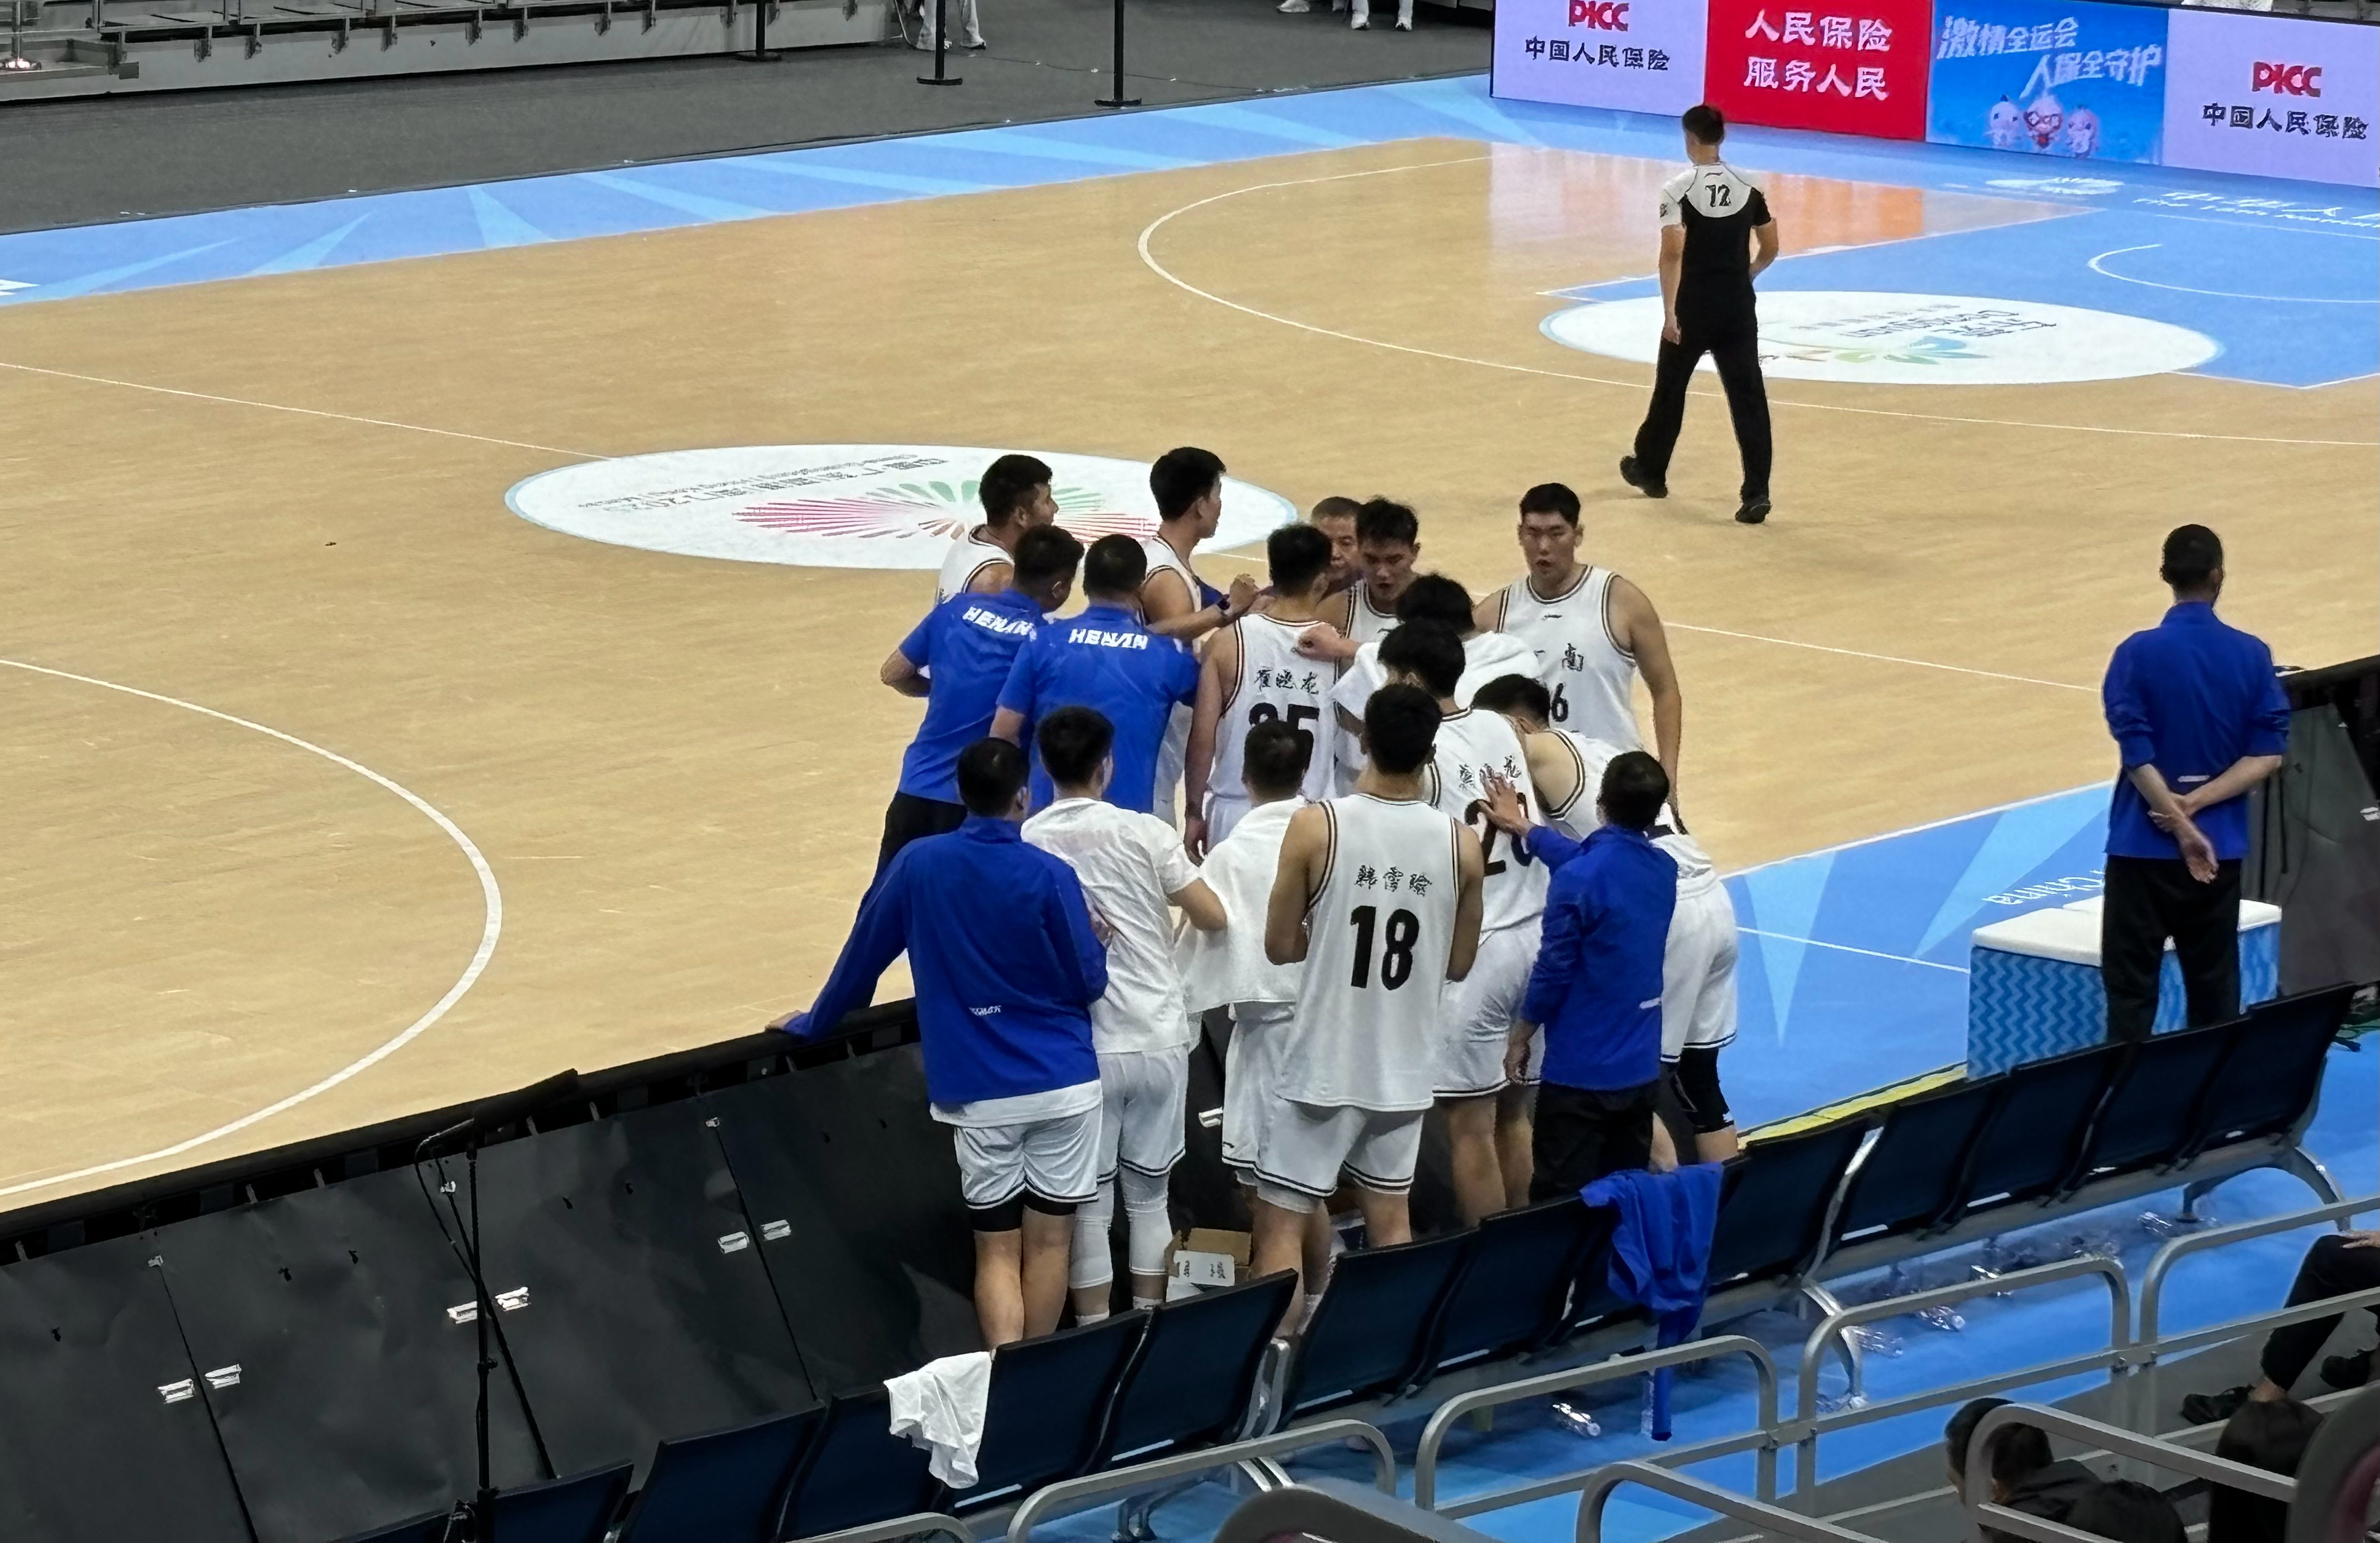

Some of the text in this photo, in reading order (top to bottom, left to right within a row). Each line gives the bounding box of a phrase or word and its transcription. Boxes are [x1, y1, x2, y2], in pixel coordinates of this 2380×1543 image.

[1568, 0, 1630, 31] PICC
[1745, 9, 1892, 52] 人民保险
[1525, 35, 1671, 71] 中国人民保险
[1936, 15, 2079, 59] 激情全运会
[1743, 56, 1890, 101] 服务人民
[2251, 61, 2322, 98] PICC
[2202, 102, 2369, 140] 中国人民保险
[1350, 905, 1420, 991] 18
